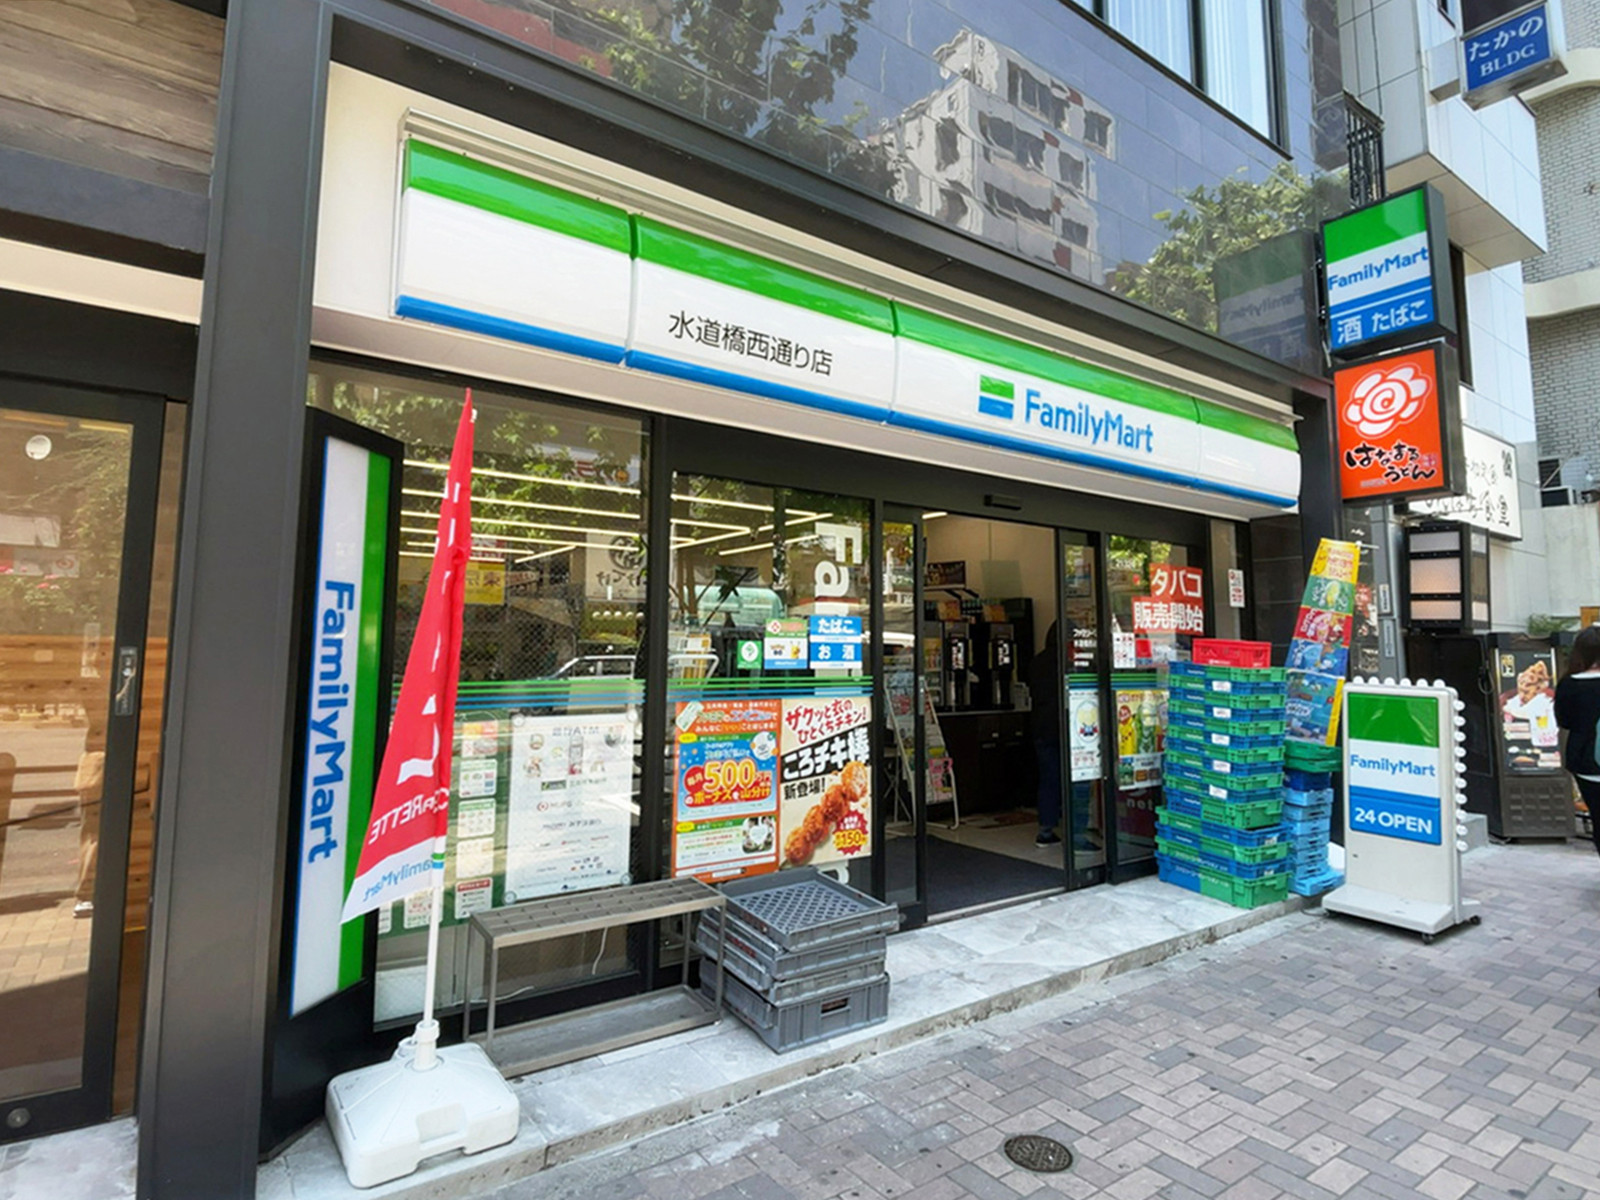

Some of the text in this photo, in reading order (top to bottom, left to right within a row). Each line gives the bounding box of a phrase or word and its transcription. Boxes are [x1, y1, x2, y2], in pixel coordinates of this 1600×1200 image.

[1468, 15, 1544, 62] たかの
[1479, 44, 1537, 78] BLDG
[1328, 245, 1430, 291] FamilyMart
[1337, 300, 1429, 344] 酒 たばこ
[669, 309, 834, 376] 水道橋西通り店
[1025, 388, 1154, 454] FamilyMart
[1345, 442, 1420, 468] はなまる
[1384, 464, 1436, 482] うどん
[1151, 567, 1202, 598] タバコ
[818, 617, 855, 634] たばこ
[1133, 601, 1204, 633] 販売開始
[308, 580, 355, 864] FamilyMart
[783, 726, 870, 780] ころチキ棒
[1350, 753, 1436, 777] FamilyMart
[703, 758, 757, 793] 500
[784, 777, 825, 800] 新登場!
